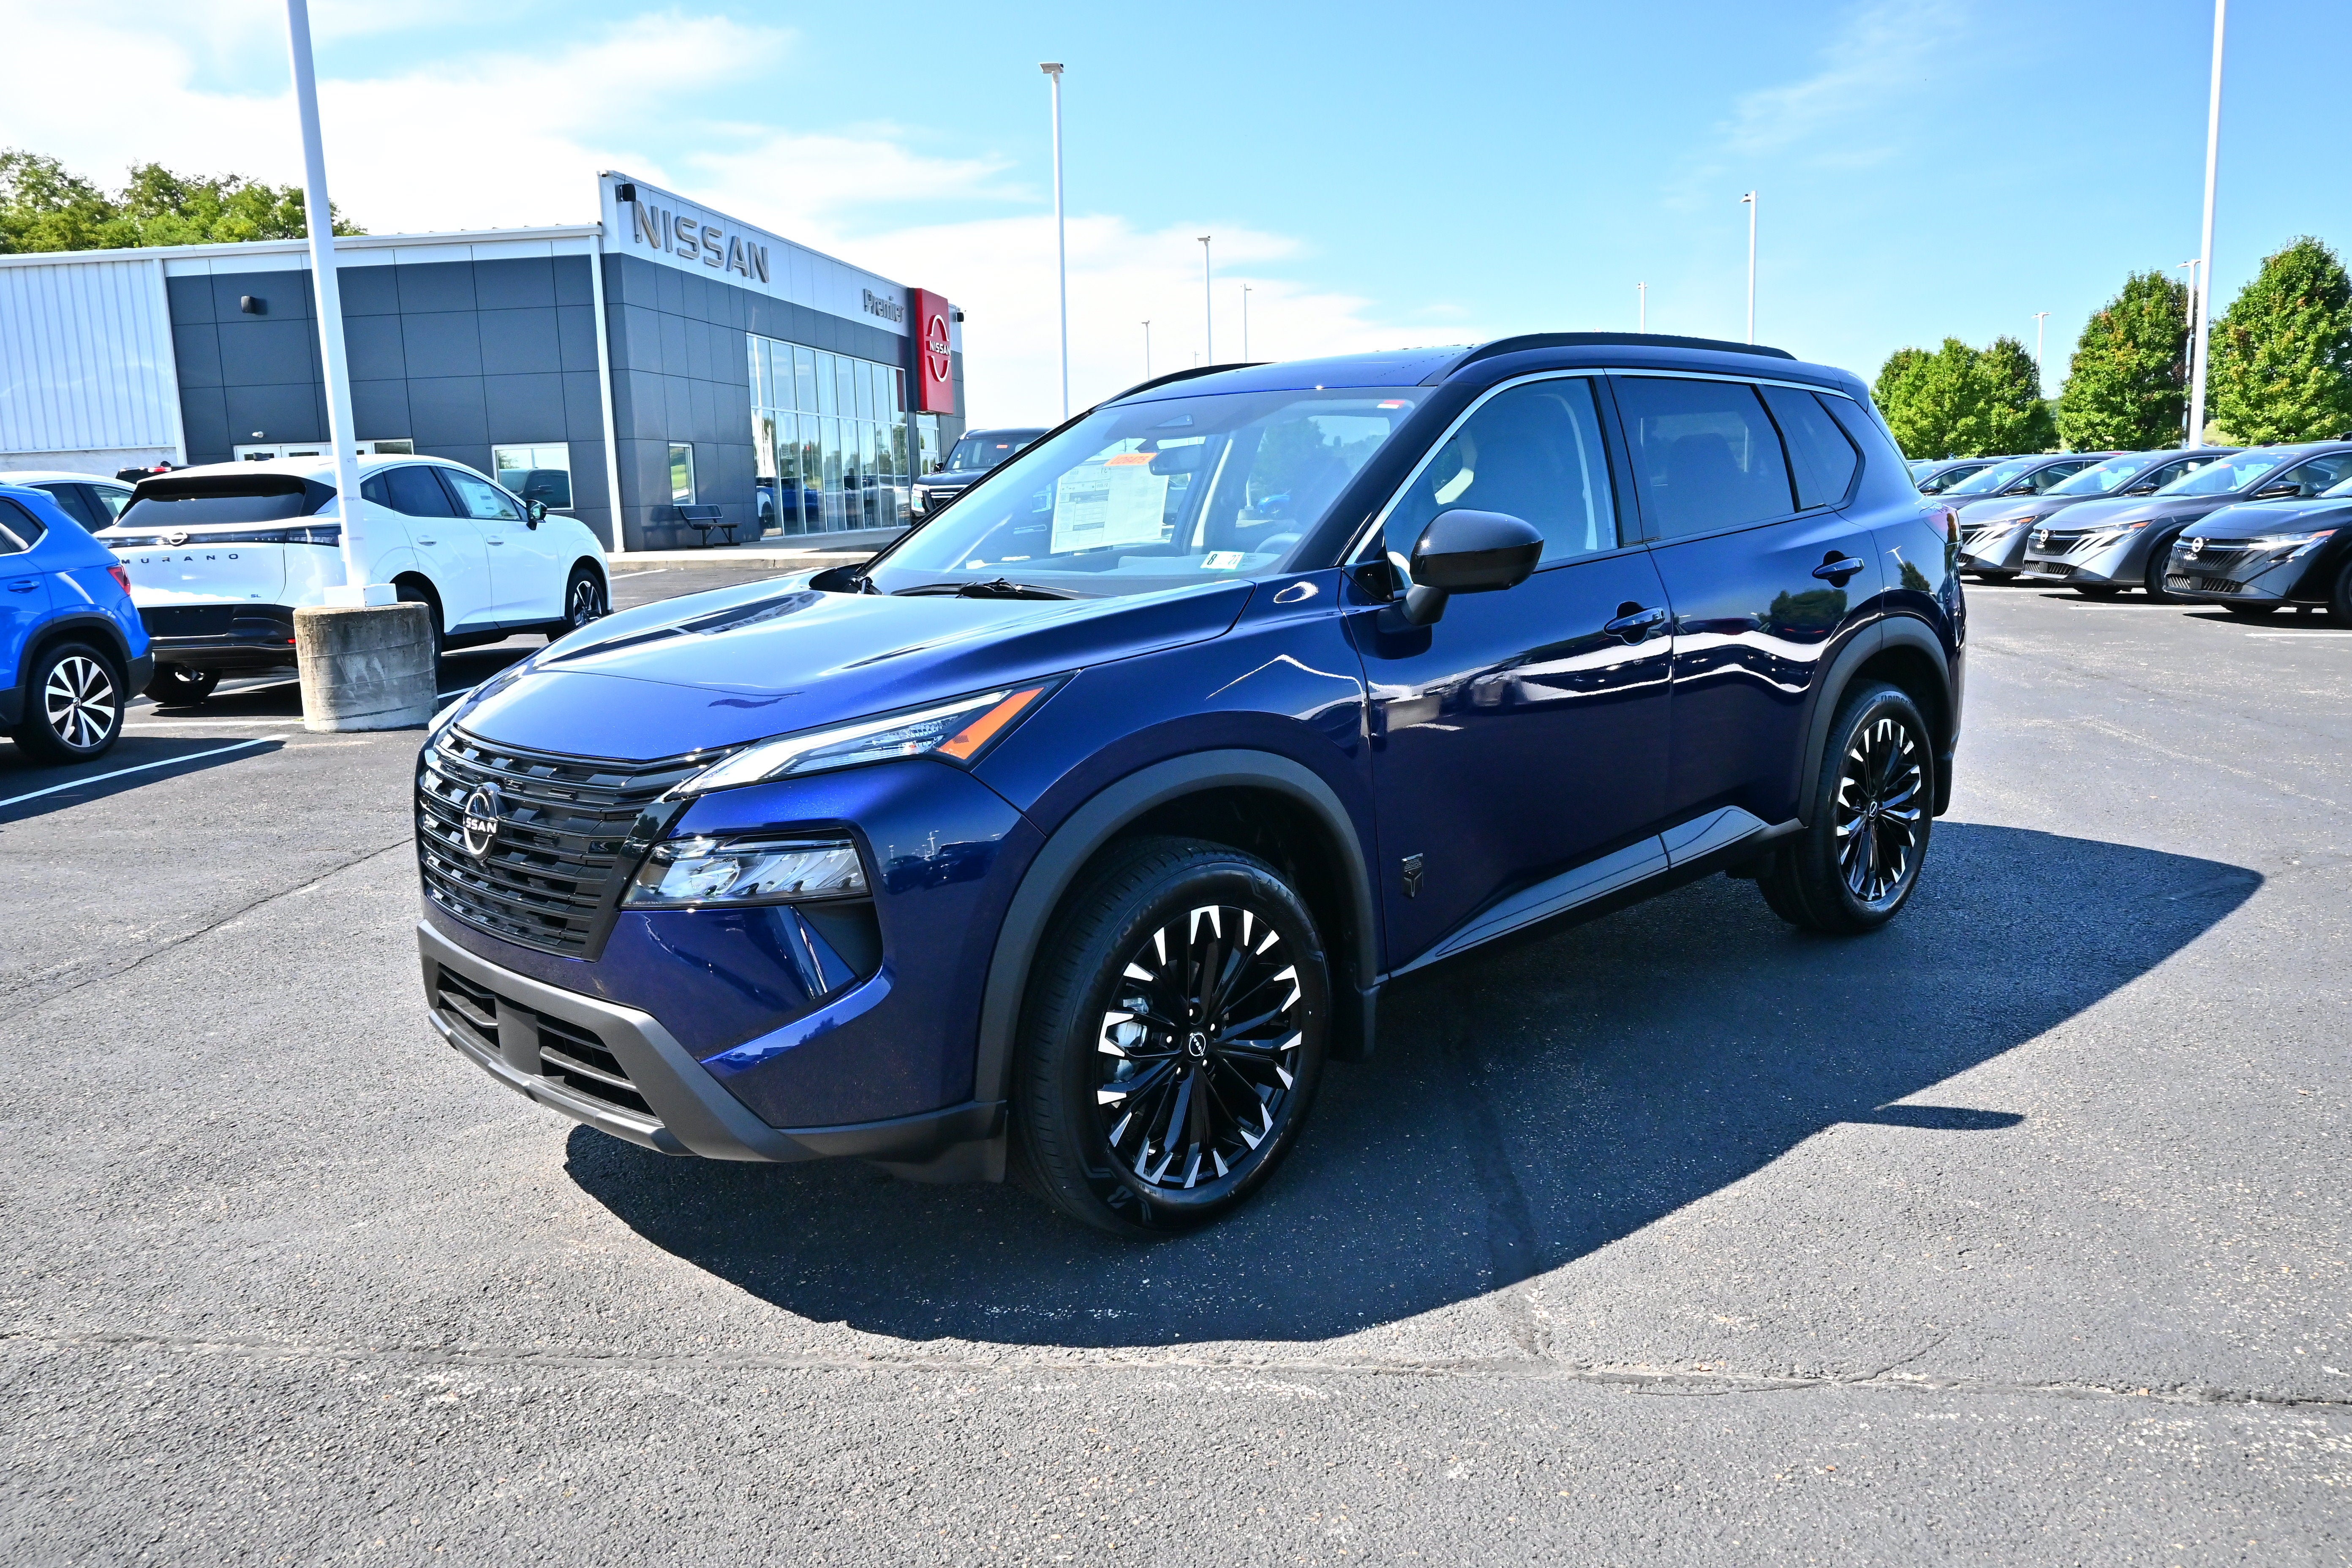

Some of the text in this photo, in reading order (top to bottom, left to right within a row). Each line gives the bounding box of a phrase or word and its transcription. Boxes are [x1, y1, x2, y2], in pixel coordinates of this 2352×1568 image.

[633, 200, 770, 283] NISSAN
[863, 288, 904, 323] Premier
[930, 340, 951, 356] NISSAN
[121, 553, 239, 564] MURANO
[1206, 554, 1218, 565] 8
[466, 817, 496, 833] SSAN
